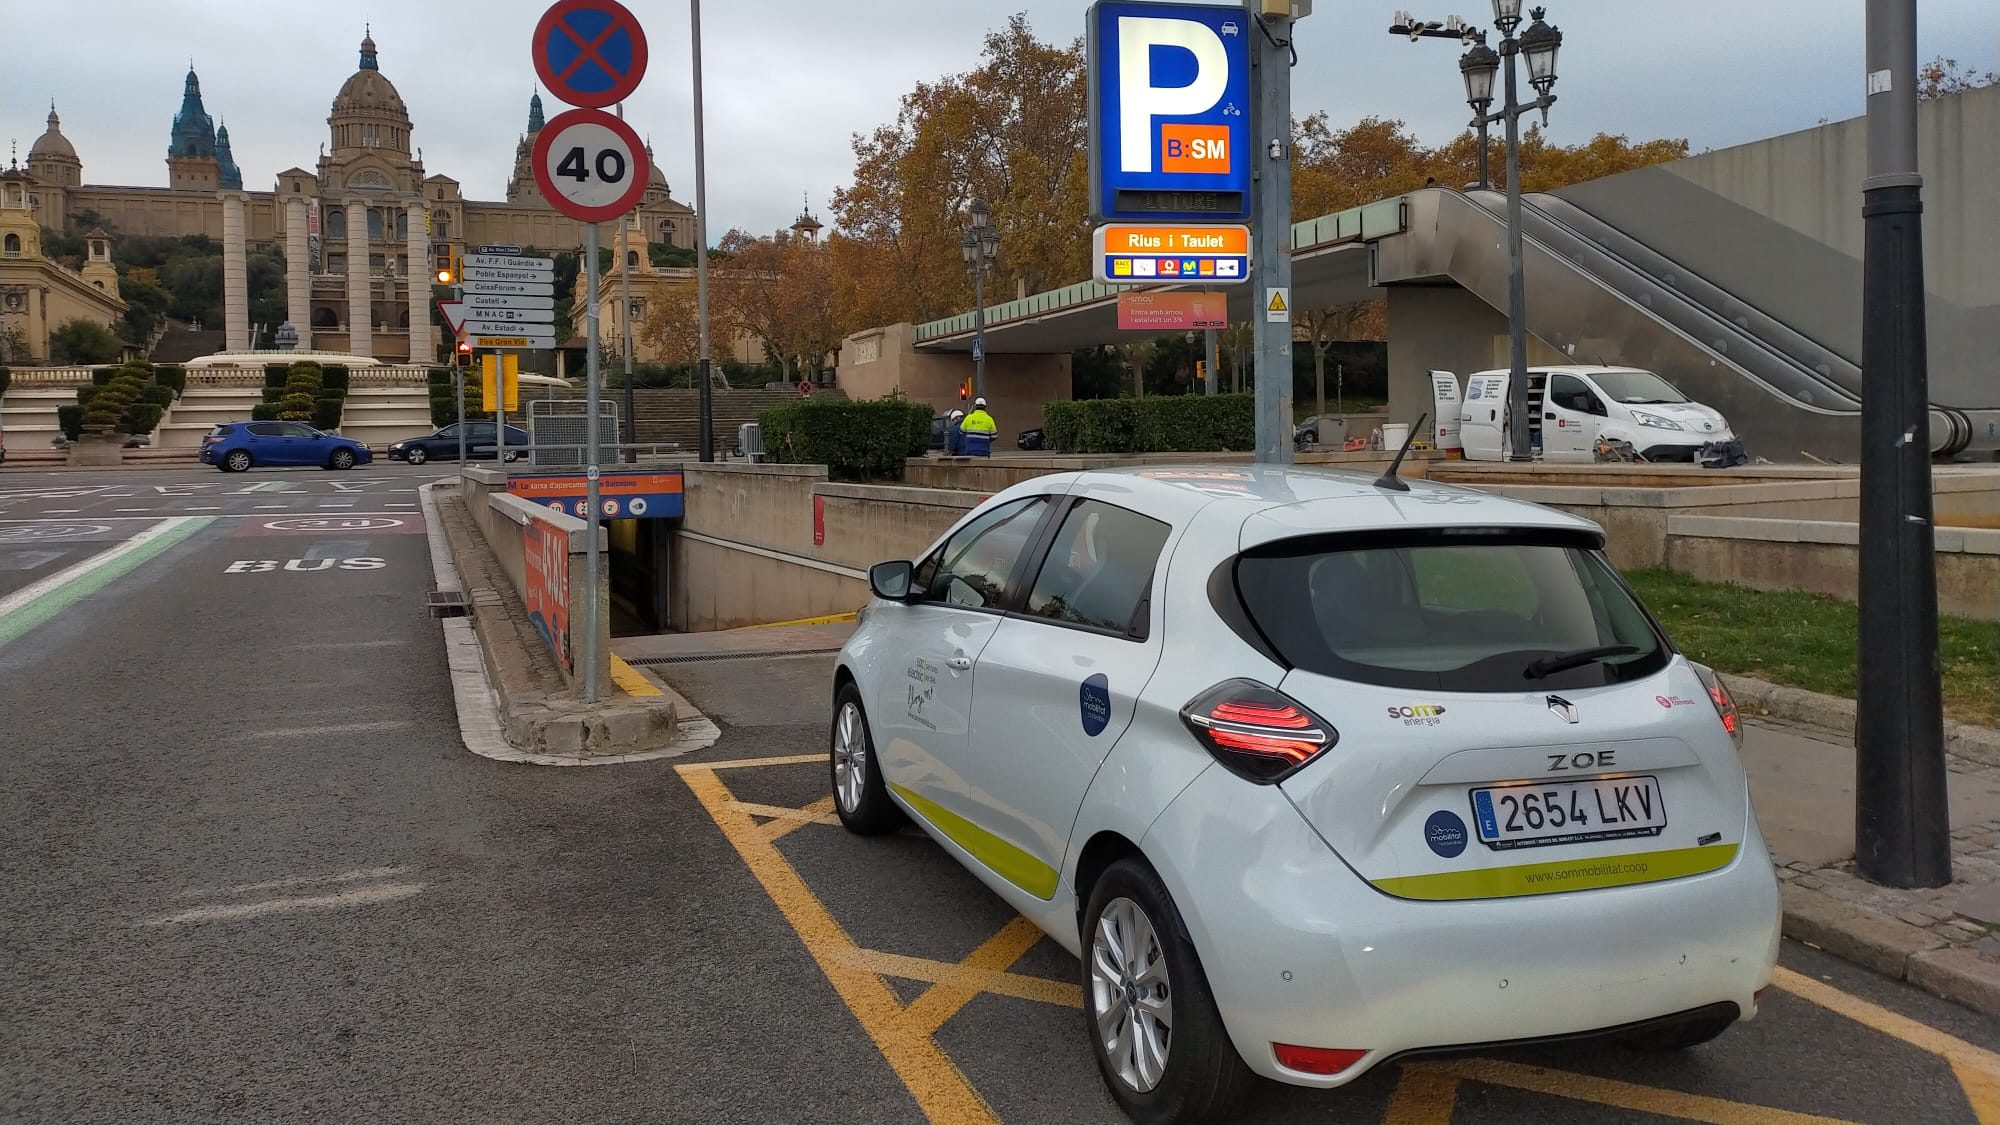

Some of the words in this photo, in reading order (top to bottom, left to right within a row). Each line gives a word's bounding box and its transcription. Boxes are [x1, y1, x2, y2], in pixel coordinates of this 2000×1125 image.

[1118, 16, 1229, 173] P
[1167, 139, 1225, 160] B:SM
[556, 147, 625, 183] 40
[1128, 233, 1161, 248] Rius
[1169, 234, 1173, 248] i
[1181, 234, 1224, 248] Taulet
[476, 257, 487, 265] Av.
[475, 270, 495, 278] Poble
[497, 271, 529, 280] Espanyol
[475, 283, 517, 291] CaixaForum
[495, 324, 517, 332] Estadi
[222, 557, 388, 574] BUS
[1387, 704, 1437, 719] som
[1547, 750, 1617, 772] ZOE
[1500, 790, 1588, 832] 2654
[1594, 784, 1652, 824] LKV
[1485, 820, 1493, 831] E
[1524, 862, 1649, 884] www.sommobilitat.coop
